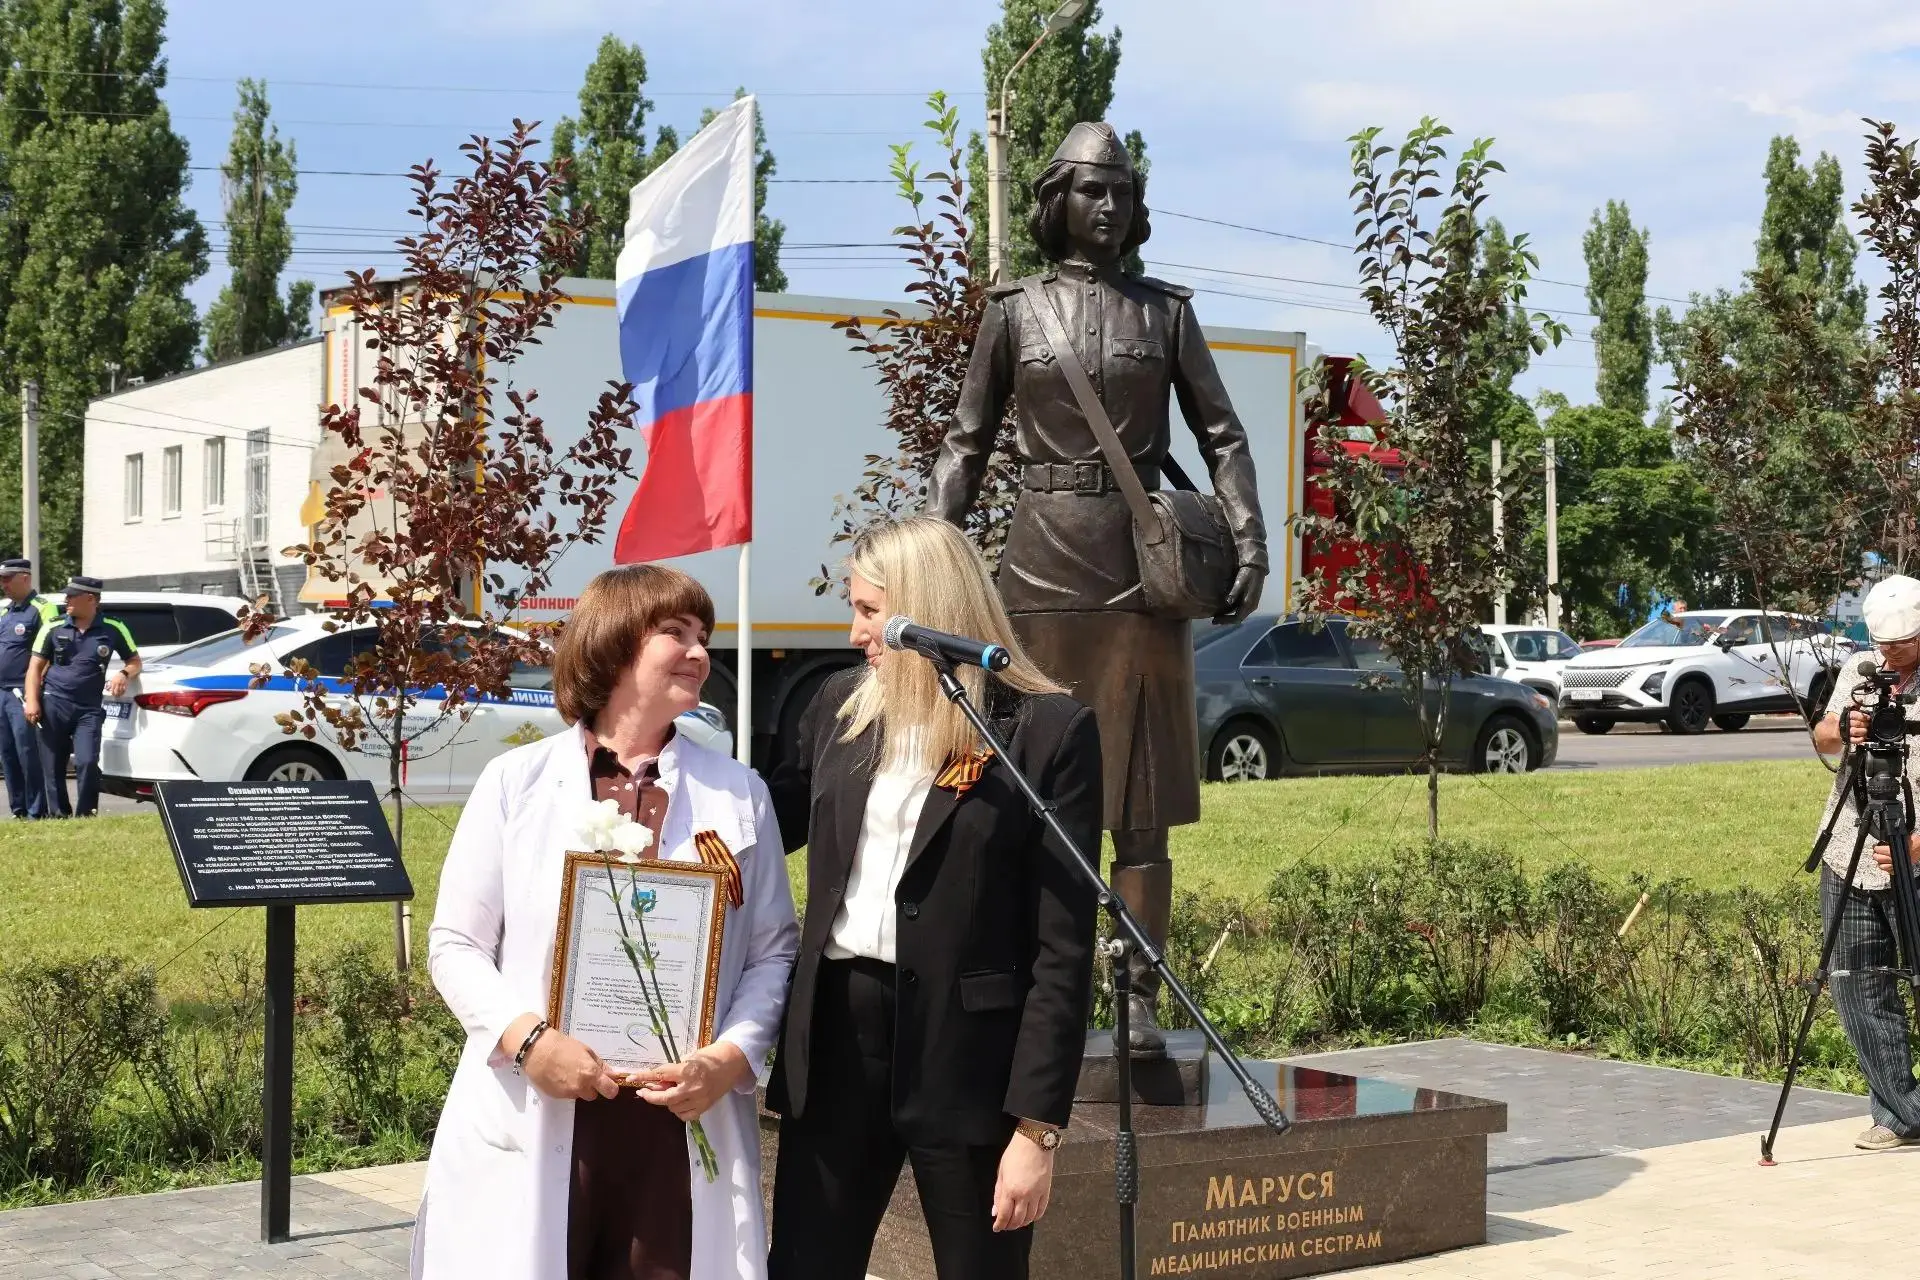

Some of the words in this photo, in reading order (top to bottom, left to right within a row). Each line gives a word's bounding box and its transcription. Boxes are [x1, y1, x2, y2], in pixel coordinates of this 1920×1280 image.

[520, 598, 579, 610] SUNHUN
[1205, 1171, 1335, 1211] МАРУСЯ
[1172, 1215, 1270, 1243] ПАМЯТНИК
[1277, 1205, 1364, 1231] ВОЕННЫМ
[1150, 1242, 1295, 1276] МЕДИЦИНСКИМ
[1301, 1231, 1382, 1256] СЕСТРАМ
